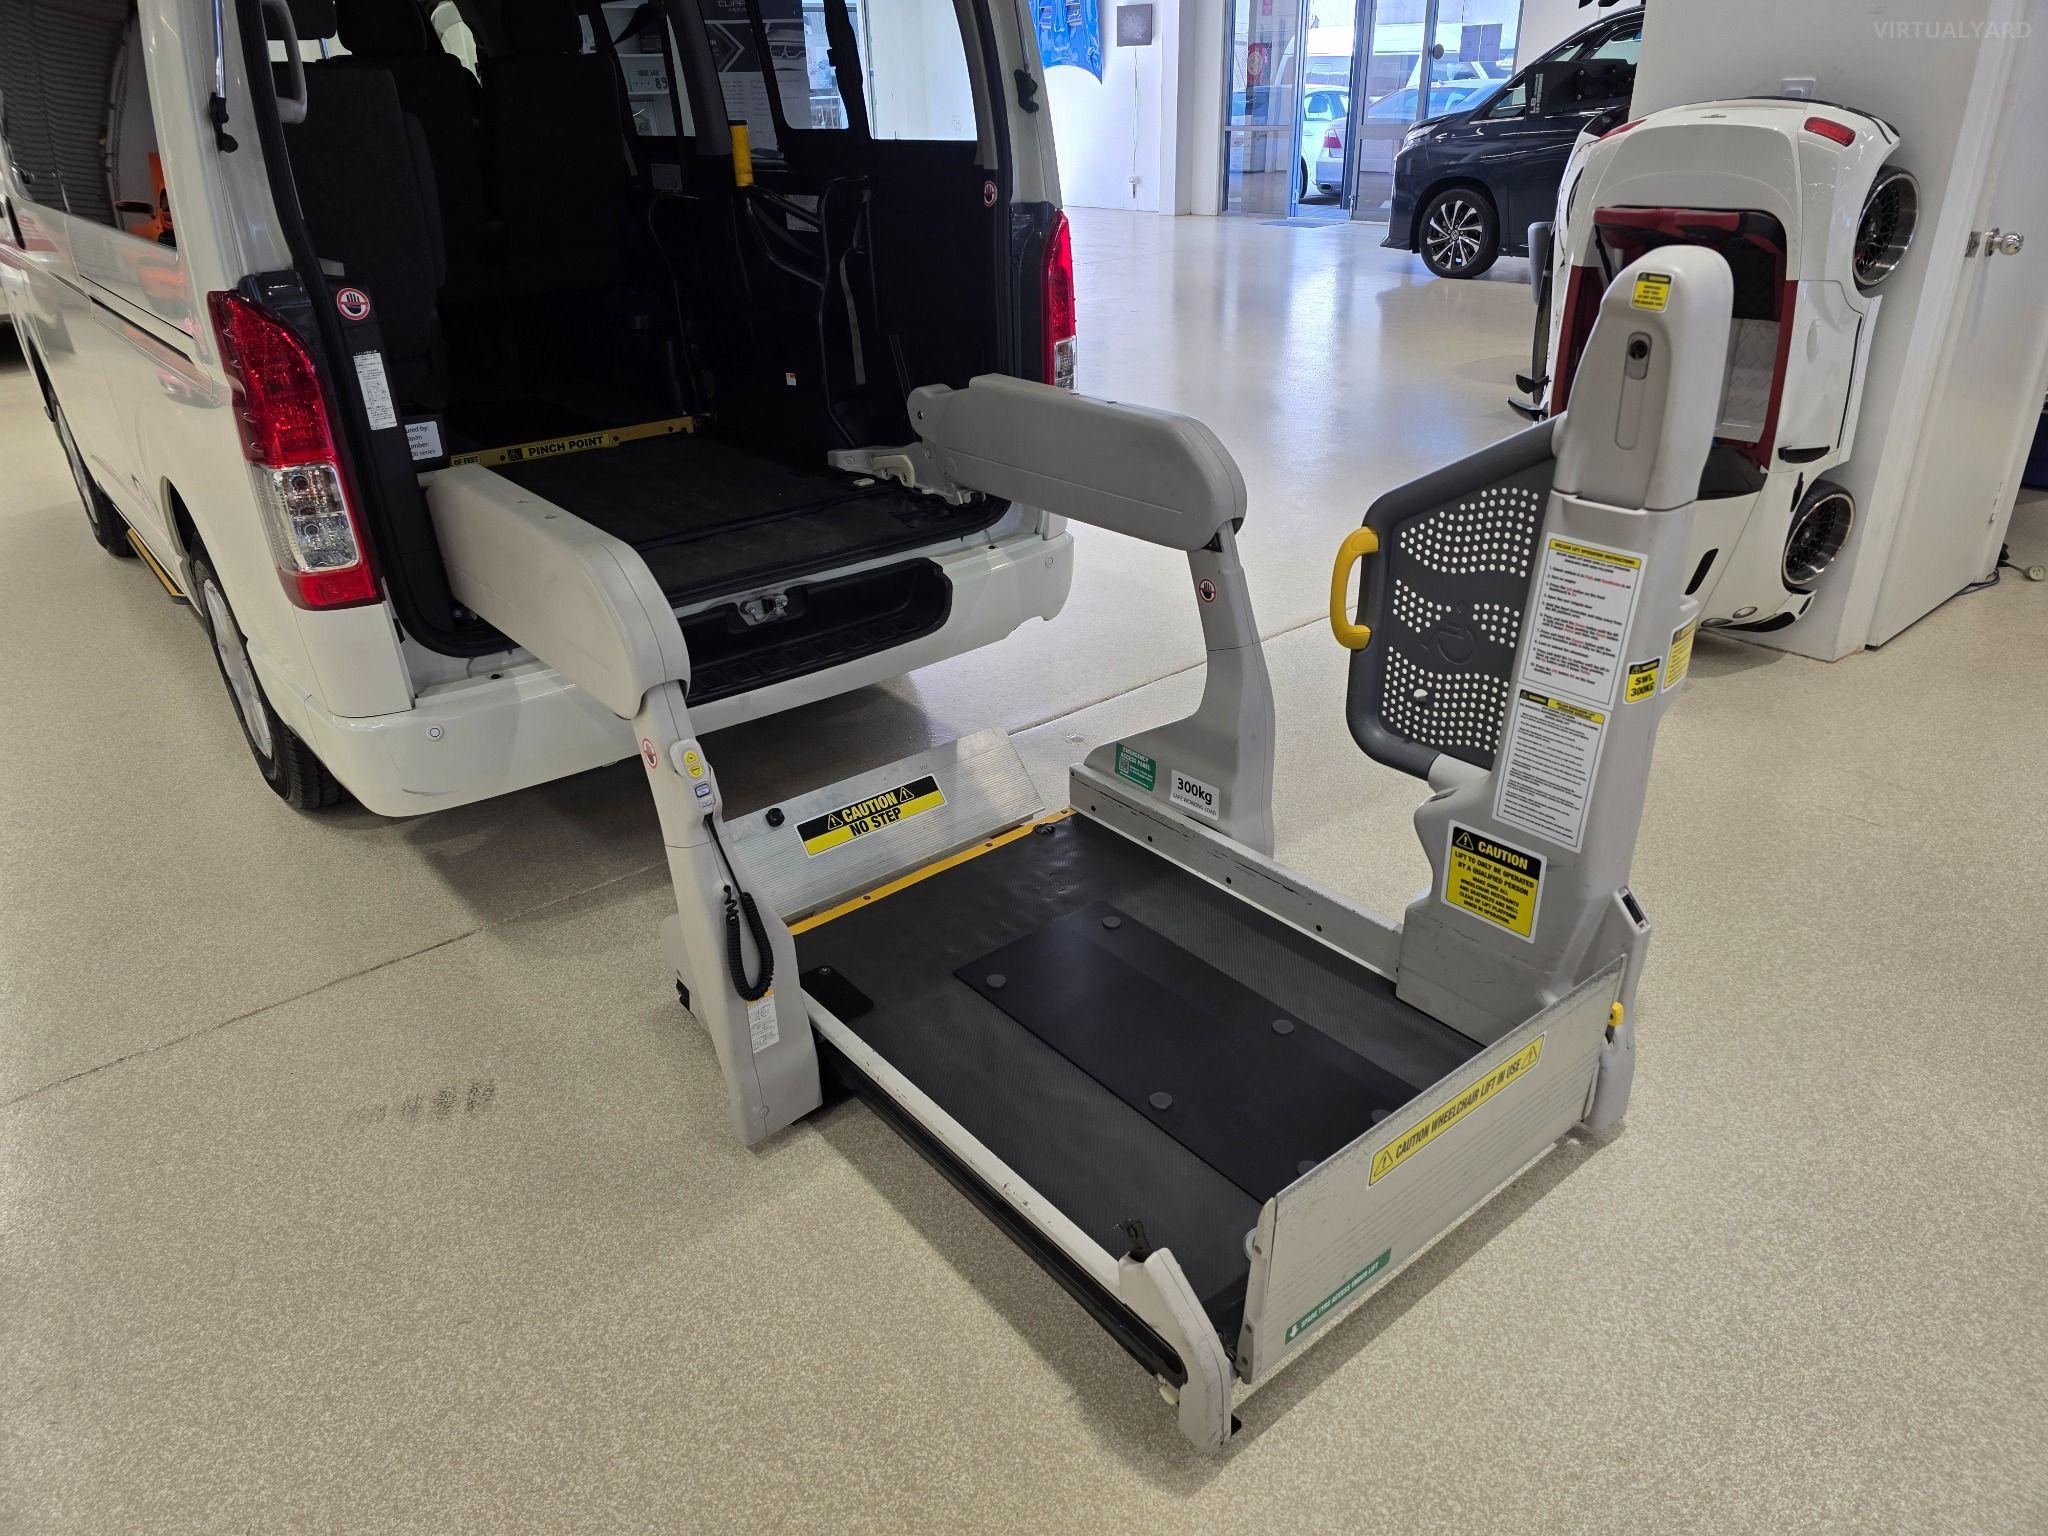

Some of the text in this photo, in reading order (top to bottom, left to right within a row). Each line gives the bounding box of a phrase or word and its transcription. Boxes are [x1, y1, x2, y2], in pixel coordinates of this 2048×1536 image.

[464, 456, 478, 464] FEET
[528, 435, 604, 457] PINCH POINT
[1635, 674, 1653, 685] SWL
[1120, 752, 1151, 771] ACCESS PANEL
[1122, 746, 1149, 763] EMERGENCY
[1173, 792, 1217, 817] SAFE WORKING LOAD
[1177, 777, 1213, 806] 300kg
[841, 792, 899, 824] CAUTION
[850, 807, 902, 837] NO STEP
[1454, 850, 1534, 888] LIFT TO ONLY BE OPERATED
[1477, 839, 1528, 871] CAUTION
[1457, 860, 1528, 896] BY A QUALIFIED PERSON
[1460, 877, 1489, 895] WHEELCHAIR
[1472, 875, 1485, 886] MAKE
[1499, 887, 1508, 895] ALL
[1459, 890, 1473, 901] CLEAR
[1481, 900, 1491, 909] LIFT
[1491, 904, 1517, 920] PLATFORM
[1395, 1059, 1522, 1159] CAUTION WHEELCHAIR LIFT IN USE
[1300, 1262, 1379, 1328] SPARE TYRE ACCESS UNDER LIFT
